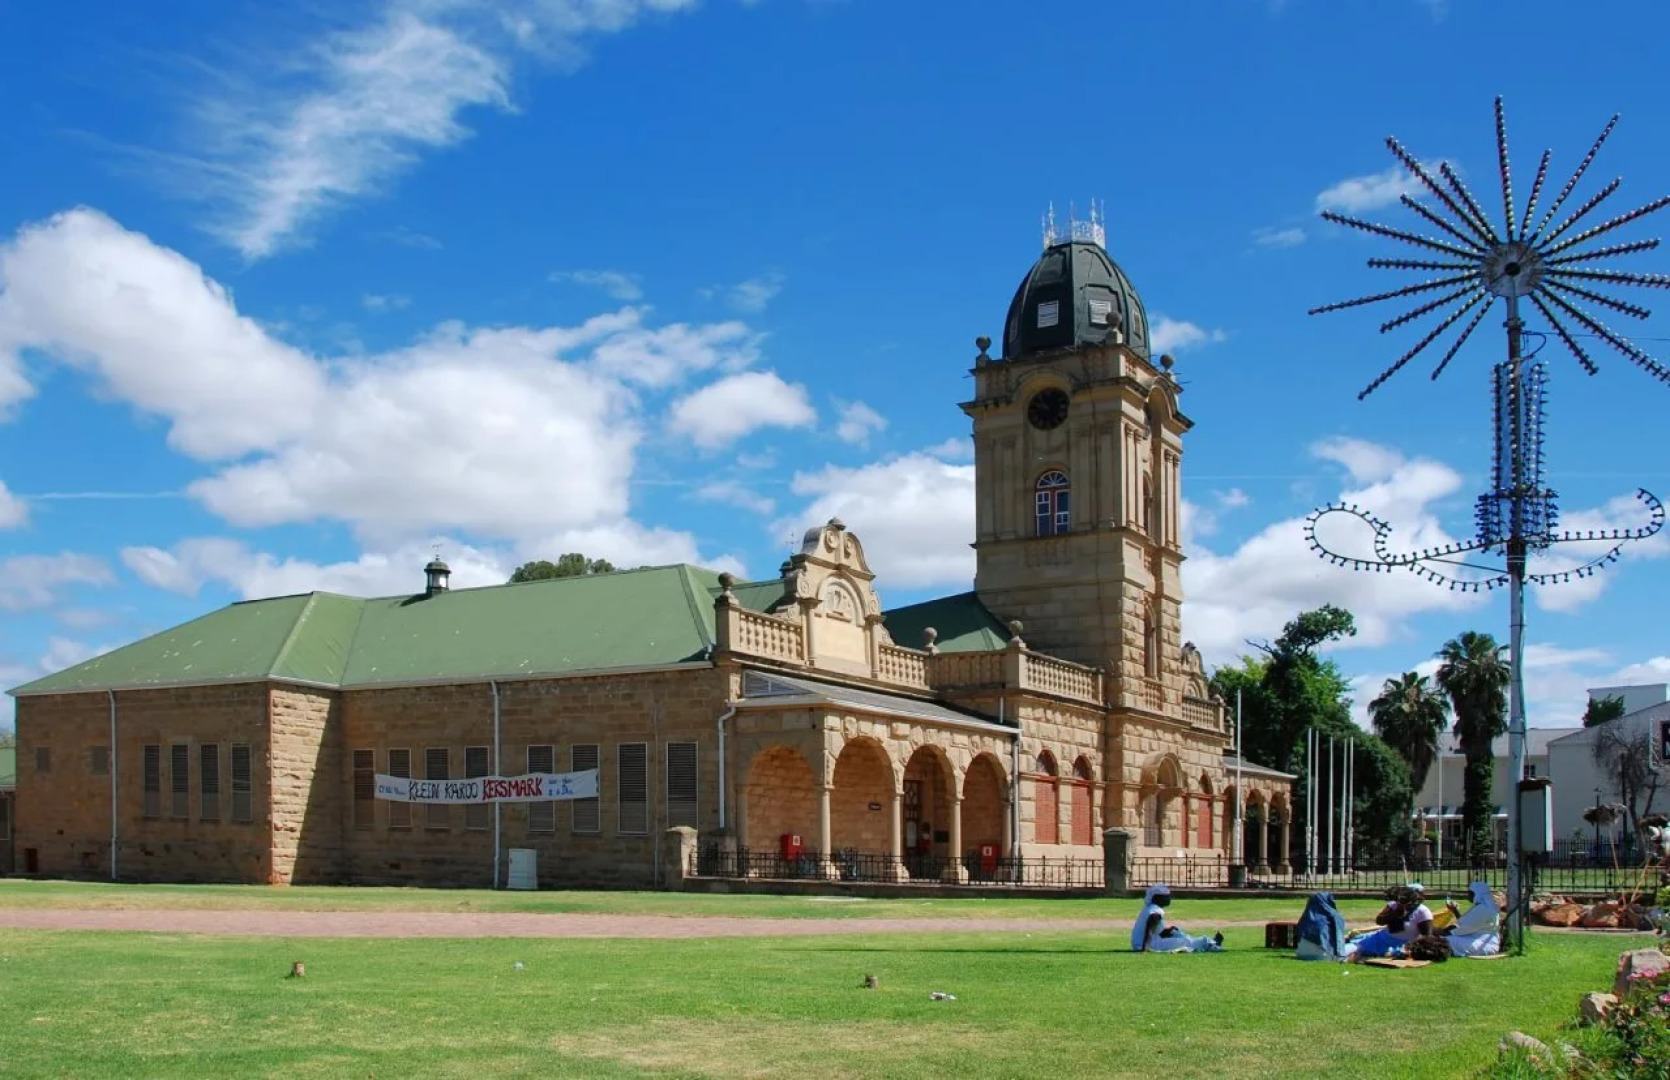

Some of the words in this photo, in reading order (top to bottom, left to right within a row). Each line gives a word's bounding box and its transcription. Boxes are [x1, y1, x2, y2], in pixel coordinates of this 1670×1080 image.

[409, 781, 439, 801] KLEIN
[445, 782, 479, 799] KAROO
[482, 777, 543, 800] KERSMARK
